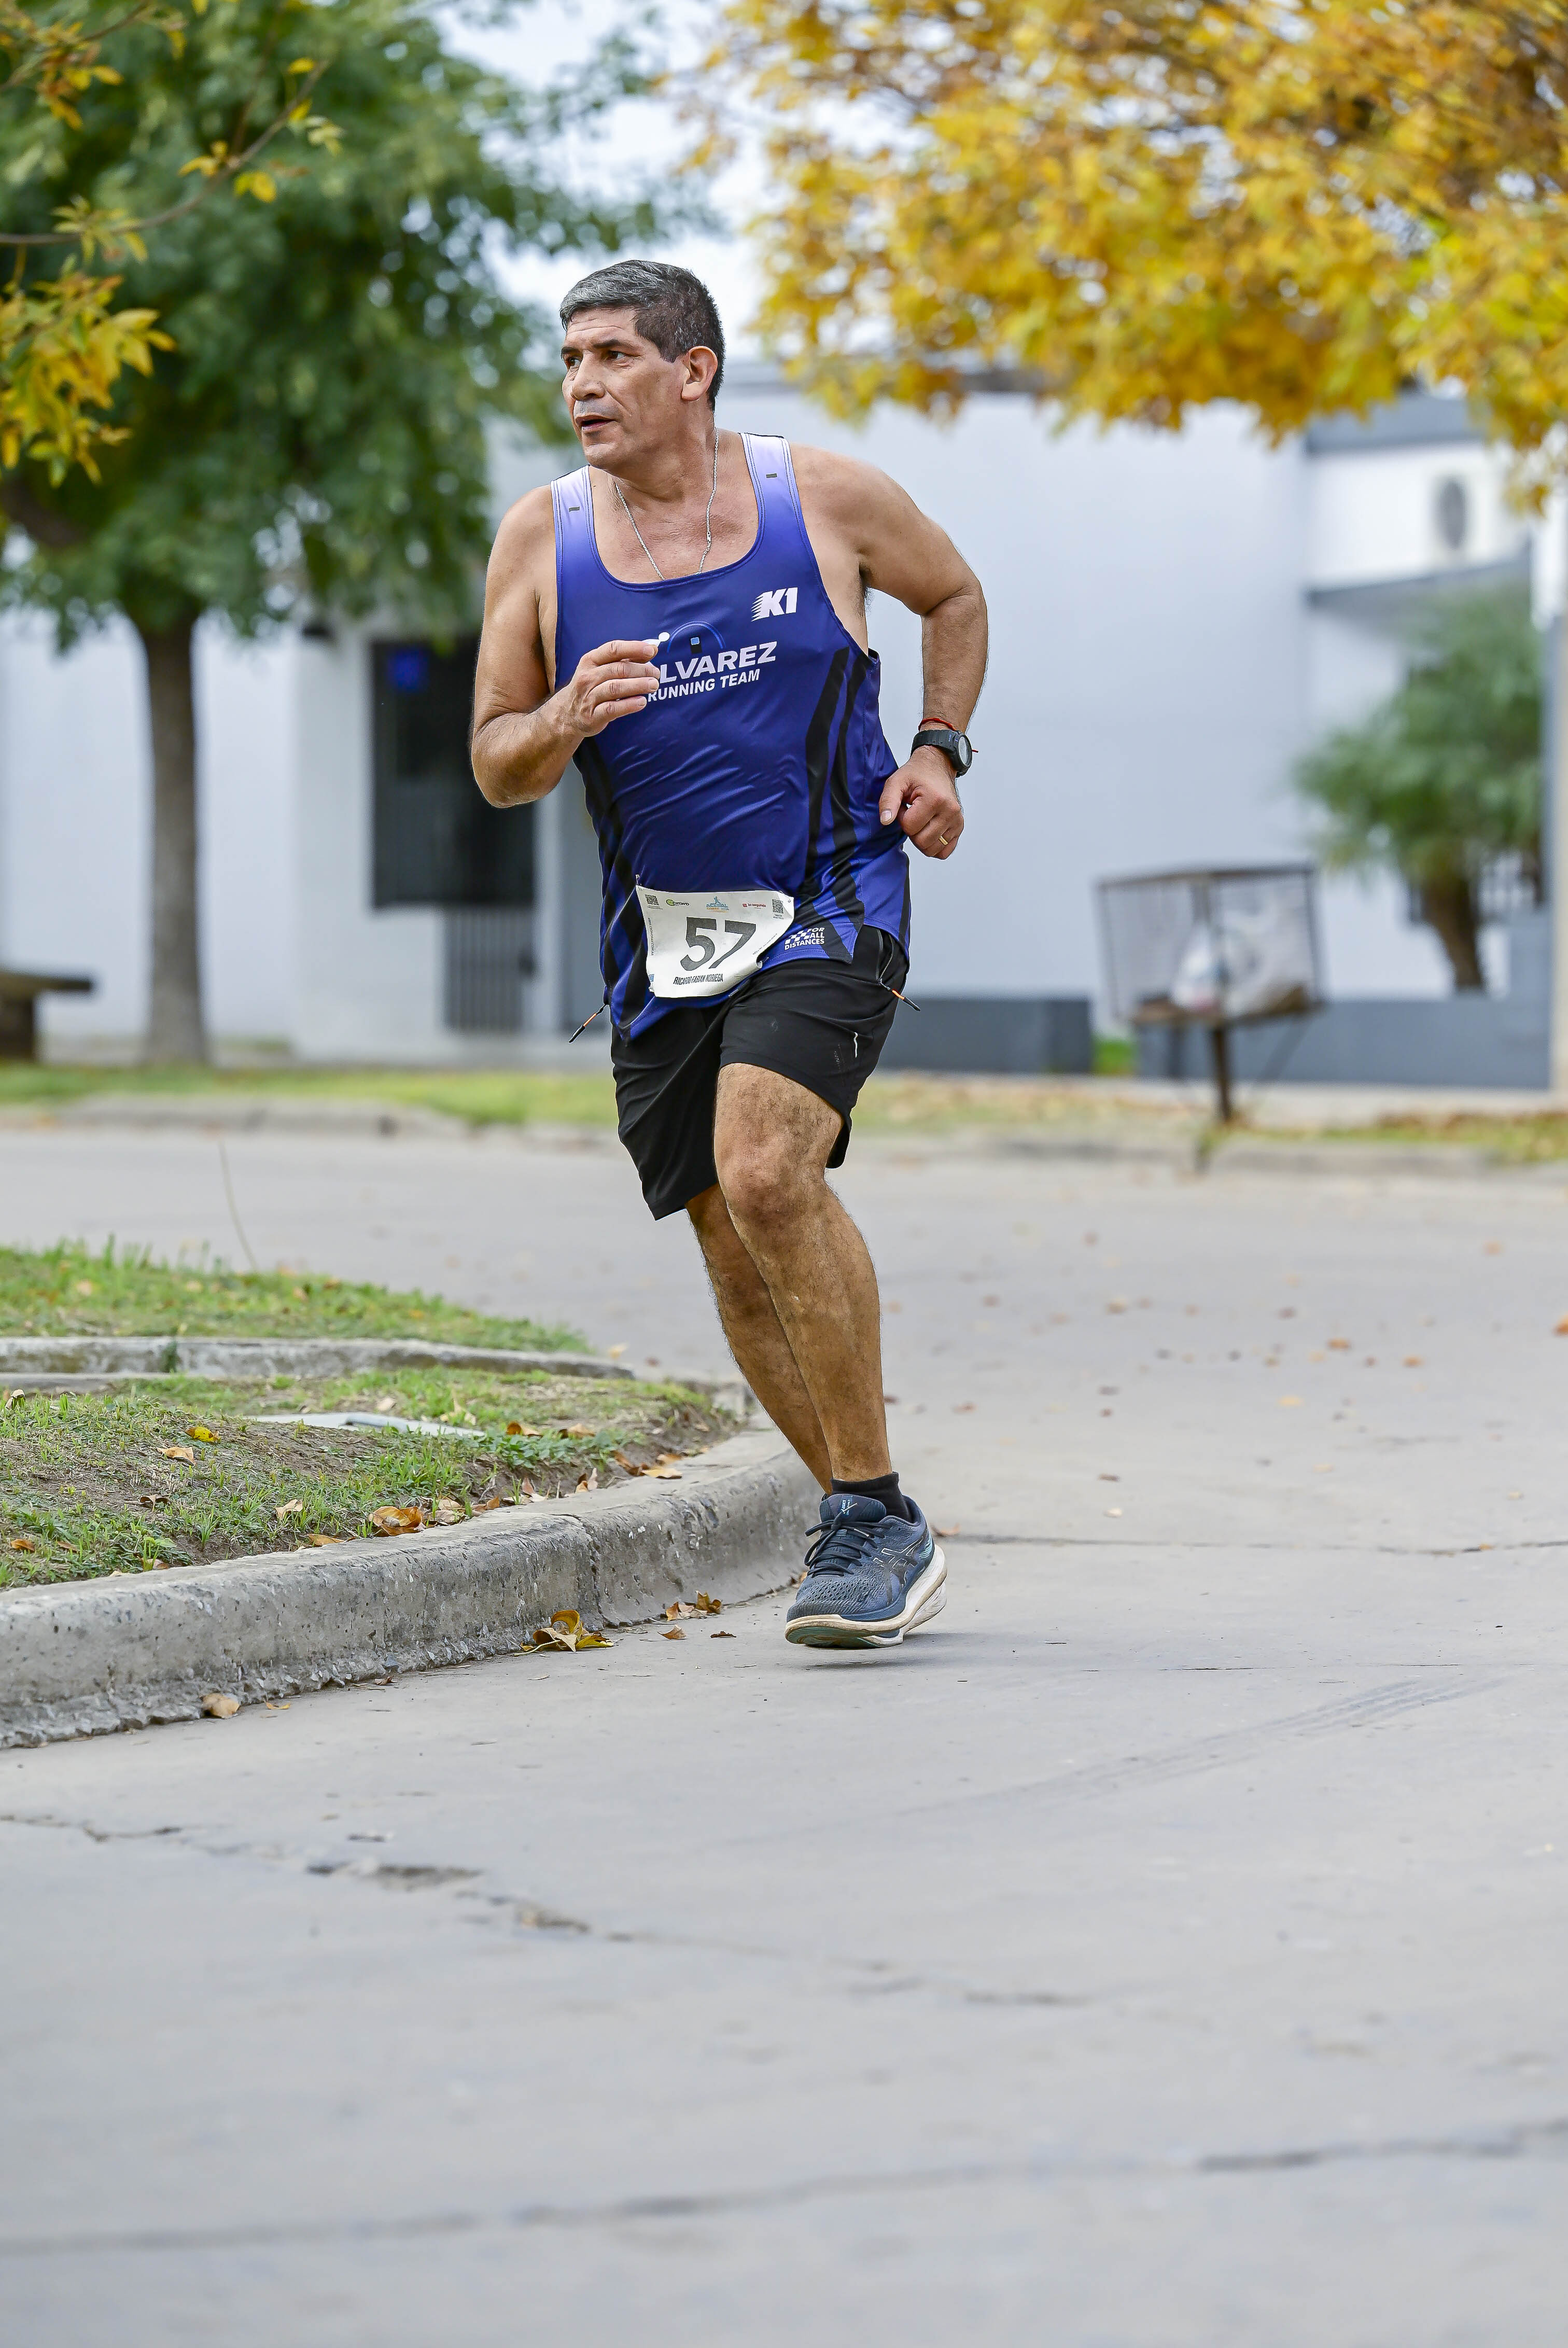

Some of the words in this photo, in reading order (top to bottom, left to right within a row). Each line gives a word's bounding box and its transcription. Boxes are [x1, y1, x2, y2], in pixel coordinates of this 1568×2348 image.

[751, 588, 798, 622] K1
[660, 641, 777, 683] LVAREZ
[648, 679, 715, 702] RUNNING
[720, 669, 760, 688] TEAM
[680, 917, 756, 971] 57
[785, 938, 824, 950] DISTANCES
[705, 973, 723, 982] NORIEGA
